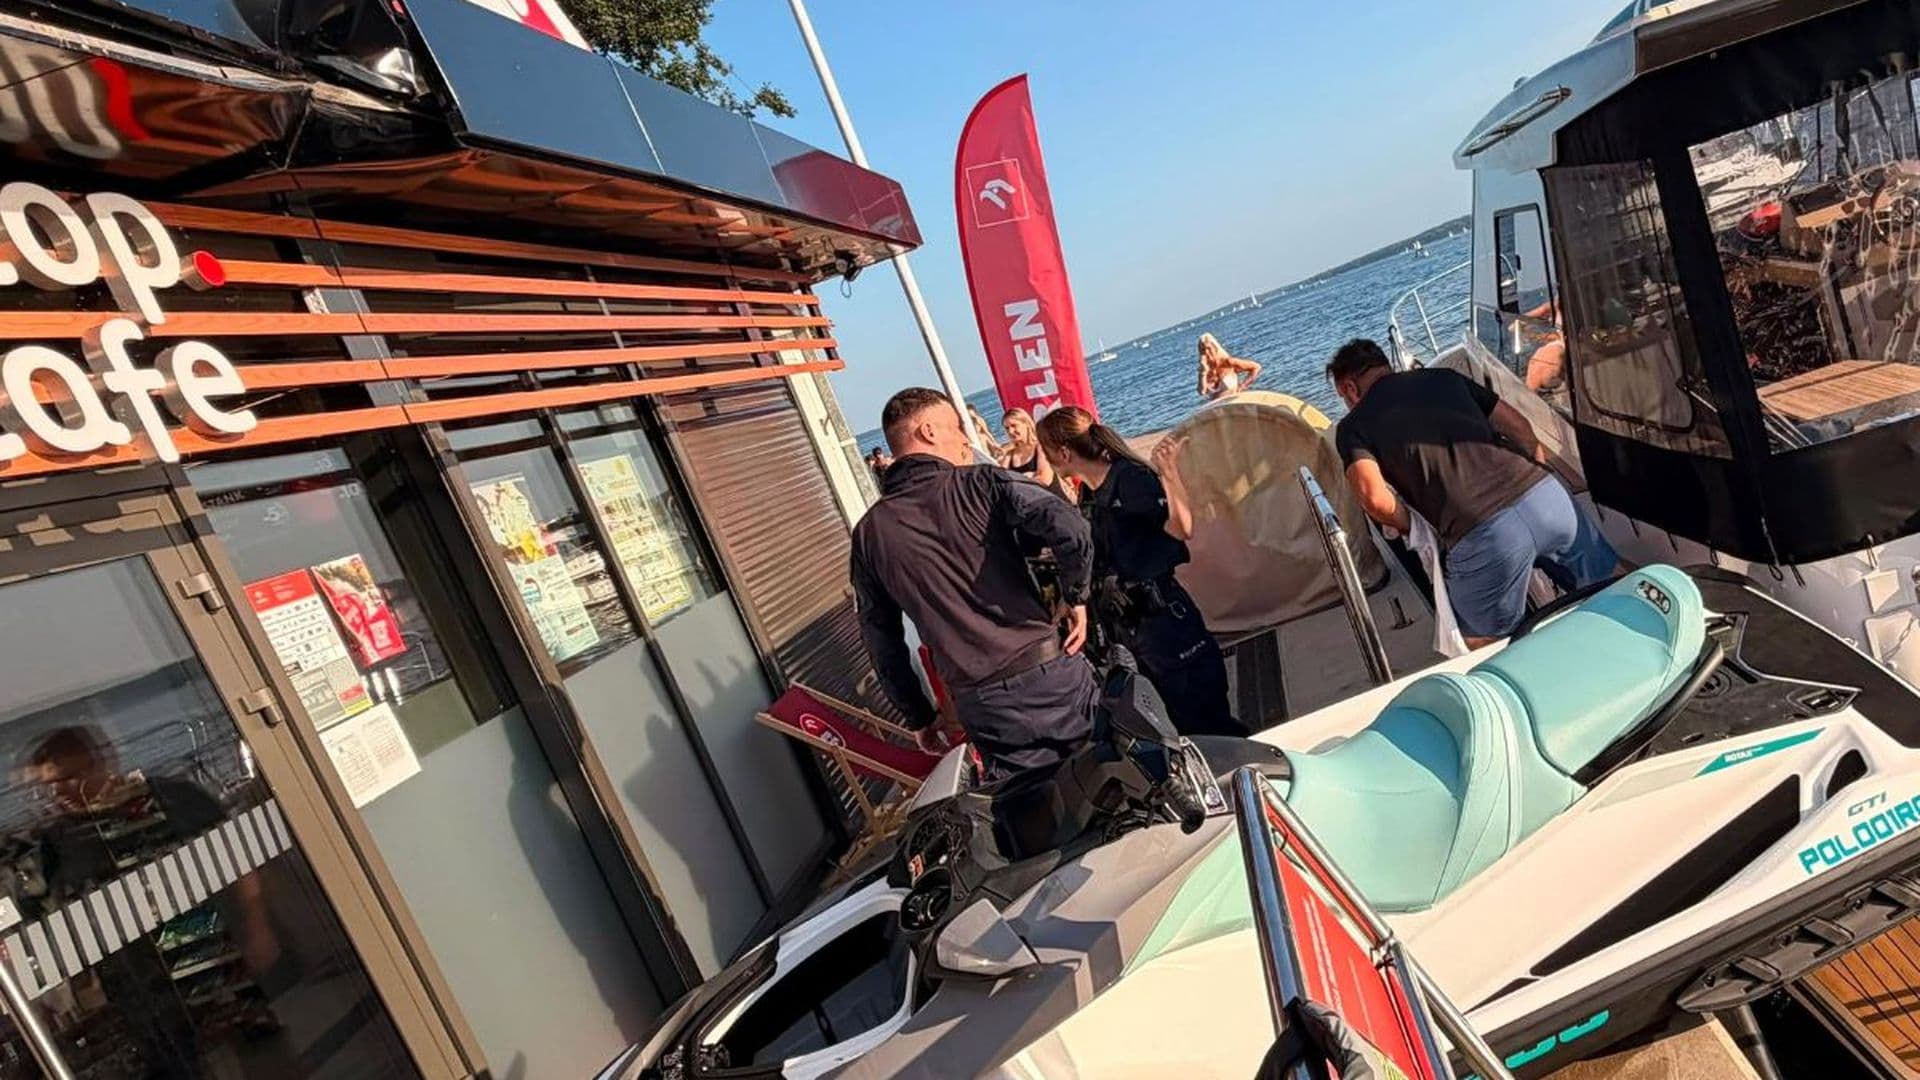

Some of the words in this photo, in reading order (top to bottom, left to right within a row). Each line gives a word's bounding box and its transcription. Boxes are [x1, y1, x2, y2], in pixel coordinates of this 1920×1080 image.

[0, 181, 225, 325] op.
[0, 318, 257, 463] afe
[1847, 791, 1887, 817] GTI
